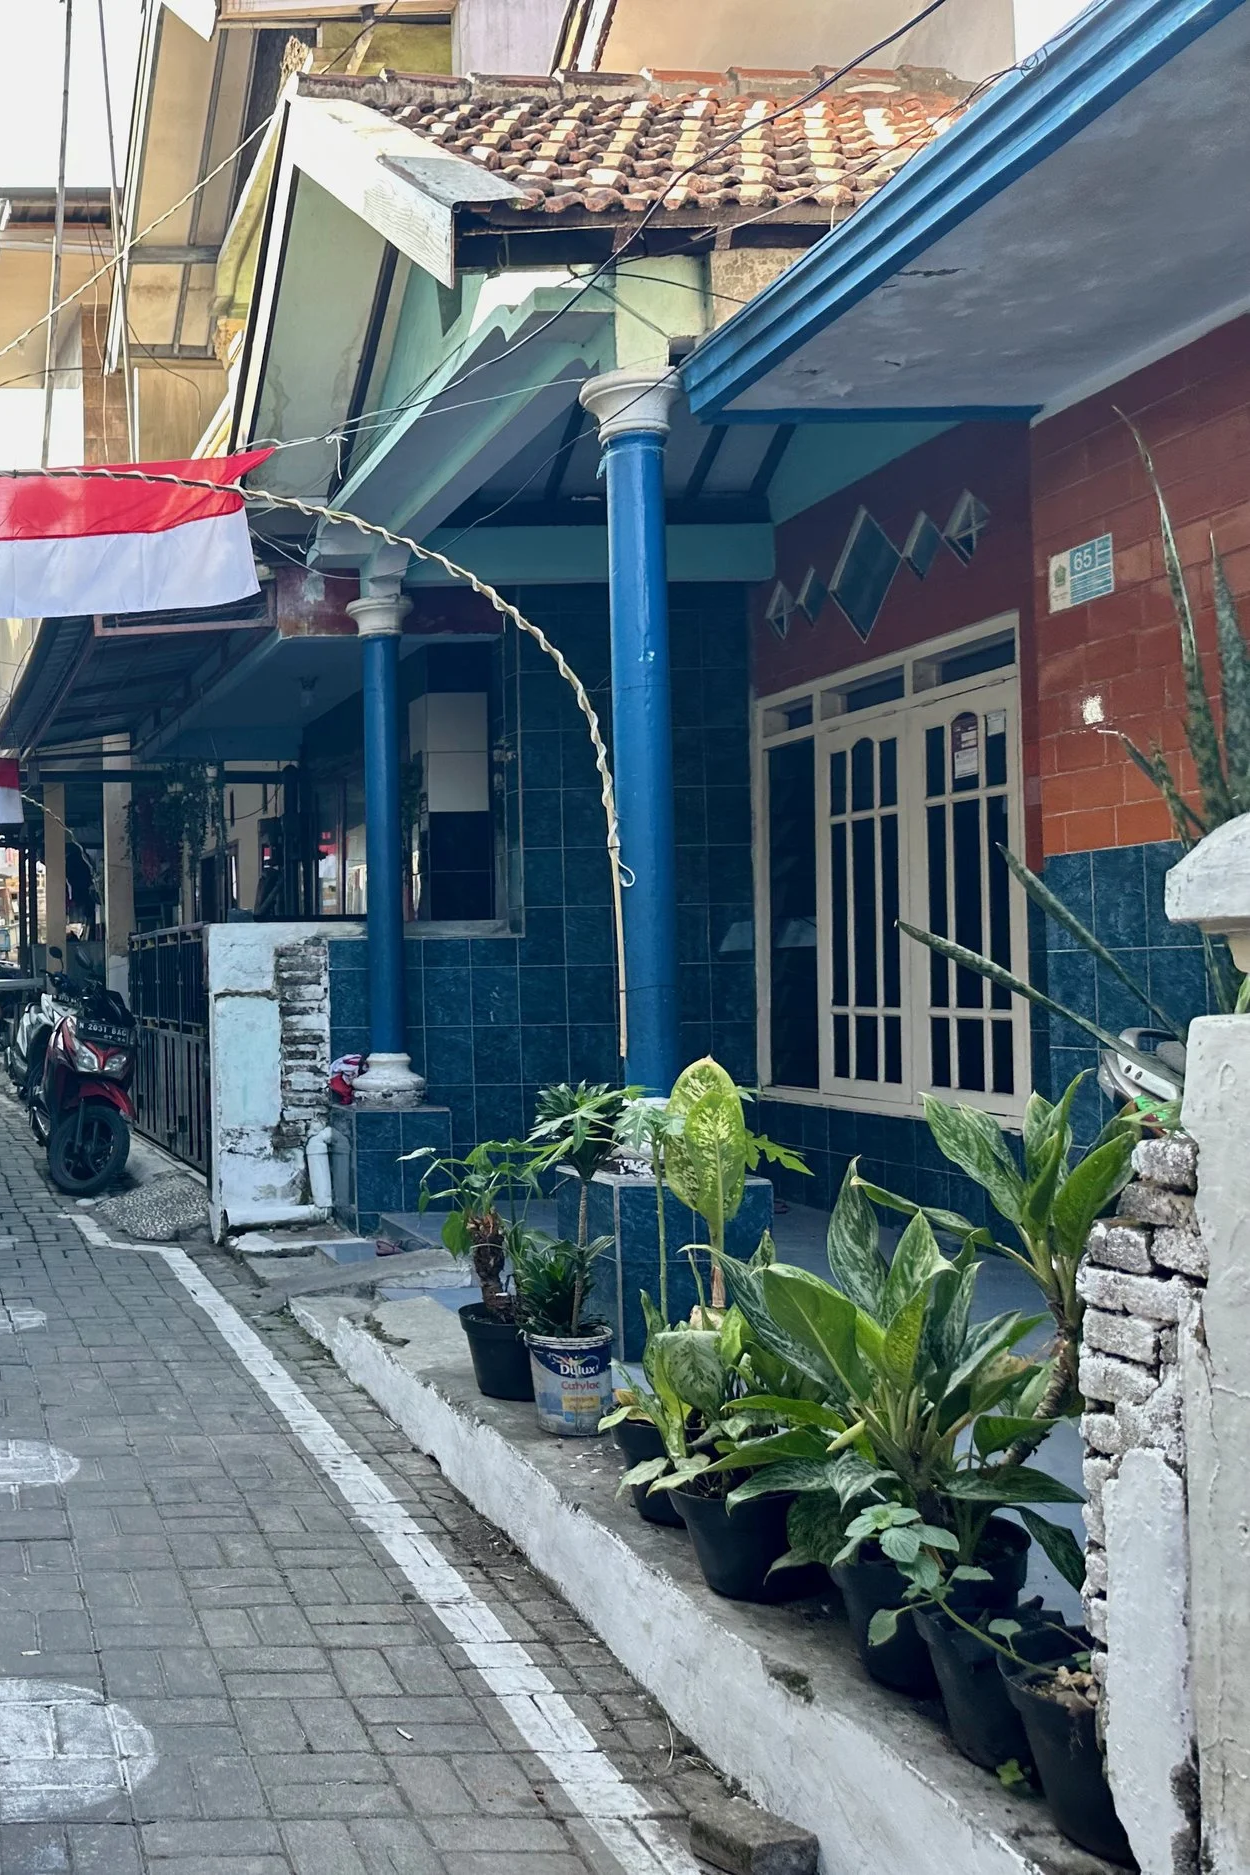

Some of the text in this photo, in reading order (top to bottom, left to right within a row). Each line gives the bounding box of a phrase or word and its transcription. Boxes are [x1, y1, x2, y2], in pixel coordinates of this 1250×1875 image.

[1073, 548, 1092, 571] 65
[560, 1364, 596, 1375] Dulux
[561, 1380, 599, 1393] Catylac
